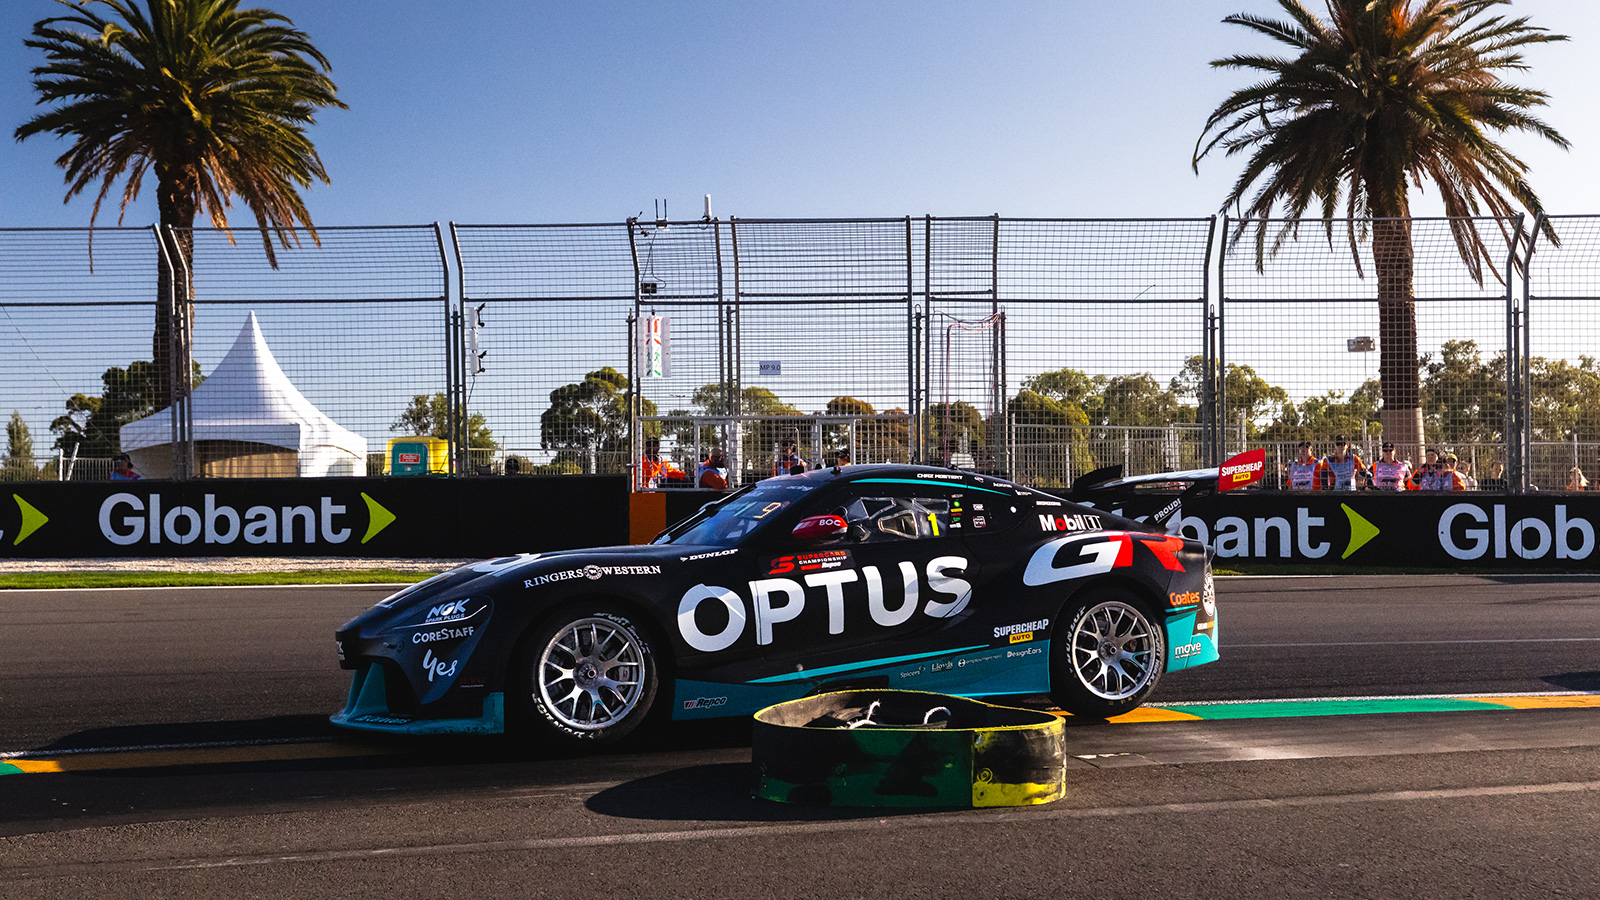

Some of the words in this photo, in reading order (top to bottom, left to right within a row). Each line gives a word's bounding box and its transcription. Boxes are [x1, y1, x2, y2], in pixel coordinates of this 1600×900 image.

[1221, 461, 1263, 477] SUPERCHEAP
[99, 492, 352, 546] Globant
[927, 513, 940, 536] 1
[1038, 514, 1087, 532] Mobil
[1112, 503, 1331, 560] bant
[1438, 502, 1600, 560] Glob
[689, 549, 739, 561] DUNLOP
[797, 550, 846, 560] SUPERCARS
[798, 555, 848, 565] CHAMPIONSHIP
[523, 568, 584, 589] RINGERS
[601, 565, 662, 576] WESTERN
[677, 555, 974, 652] OPTUS
[1169, 591, 1200, 606] Coates
[426, 598, 470, 619] NGK
[443, 613, 465, 621] PLUGS
[993, 618, 1049, 638] SUPERCHEAP
[1011, 633, 1031, 642] AUTO
[1174, 642, 1202, 656] move
[696, 696, 728, 709] Repco
